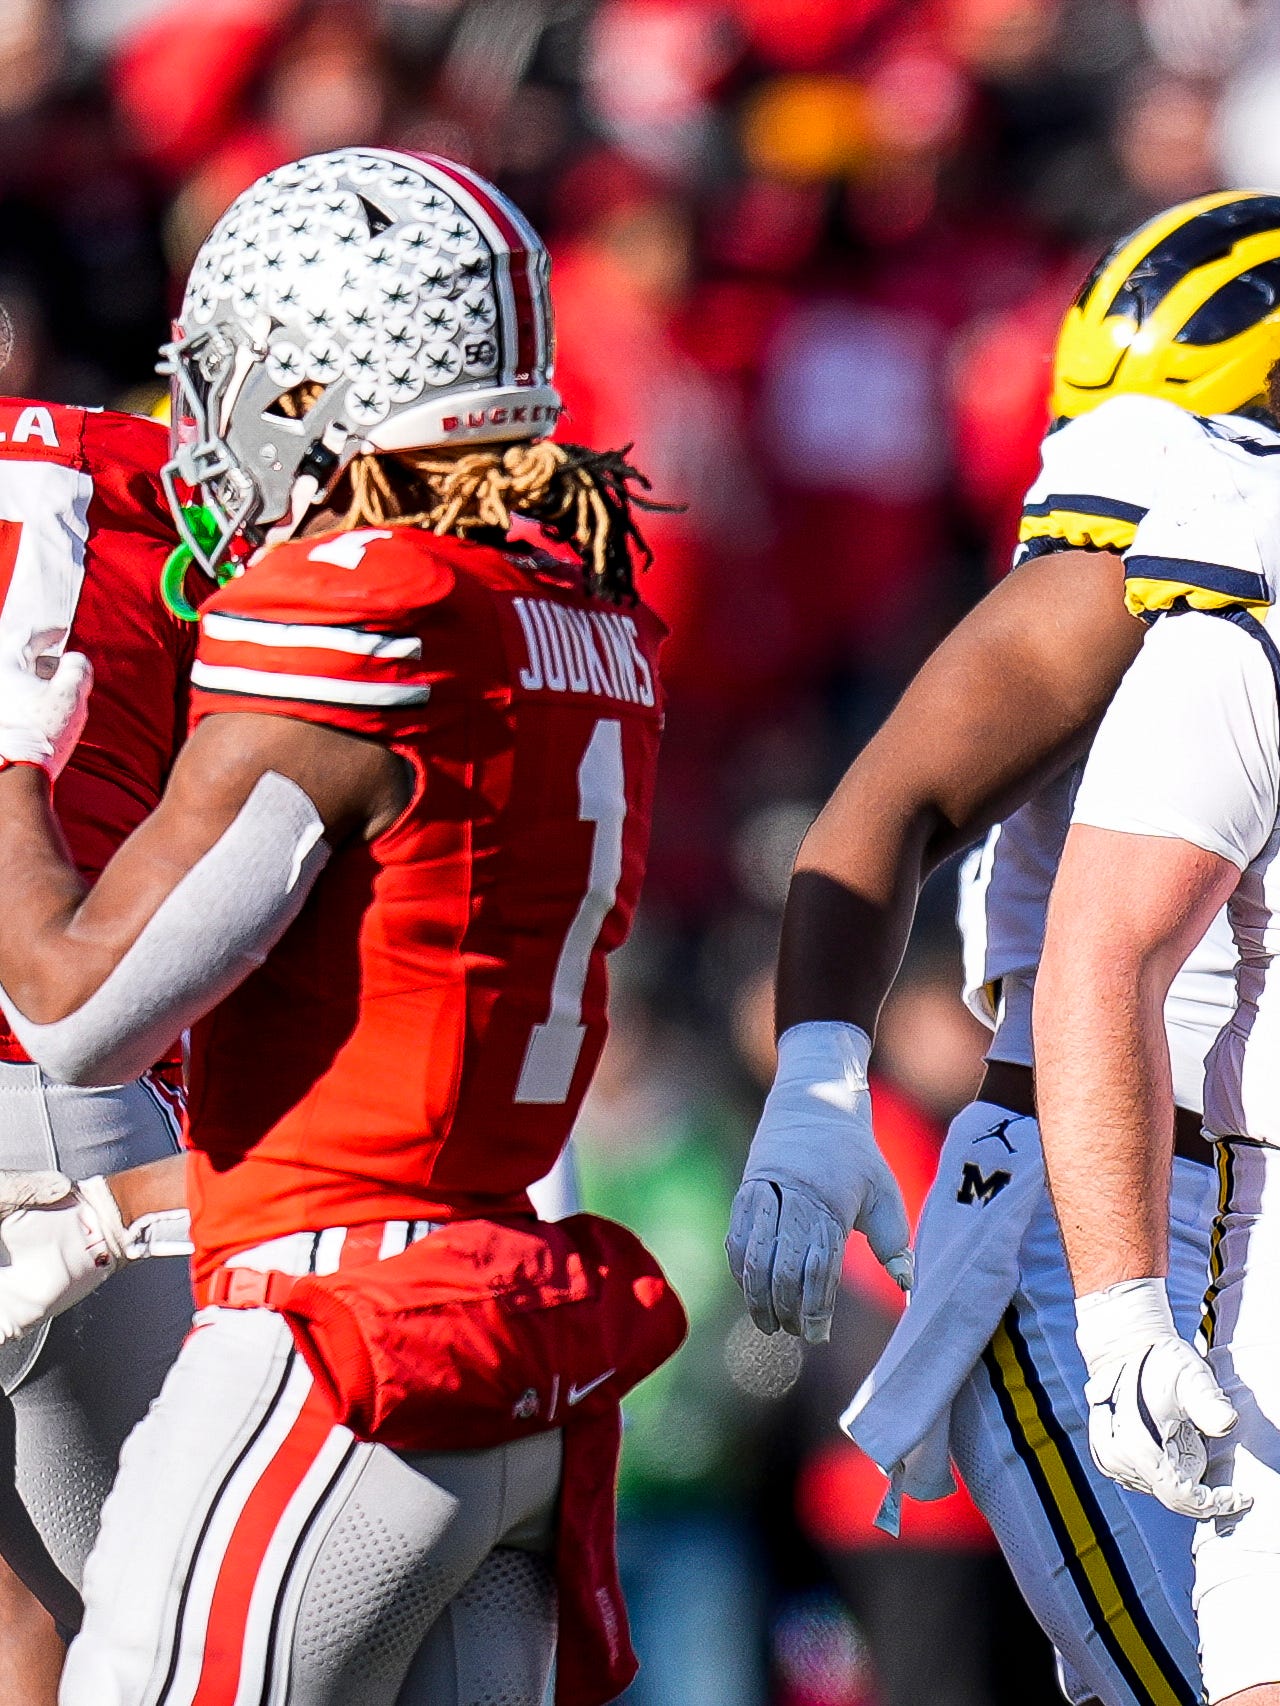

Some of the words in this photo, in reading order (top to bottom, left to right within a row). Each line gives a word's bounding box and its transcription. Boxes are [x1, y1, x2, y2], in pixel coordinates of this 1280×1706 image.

[0, 406, 60, 448] A
[512, 597, 655, 707] JUDKINS
[514, 719, 627, 1103] 1
[956, 1161, 1014, 1209] M
